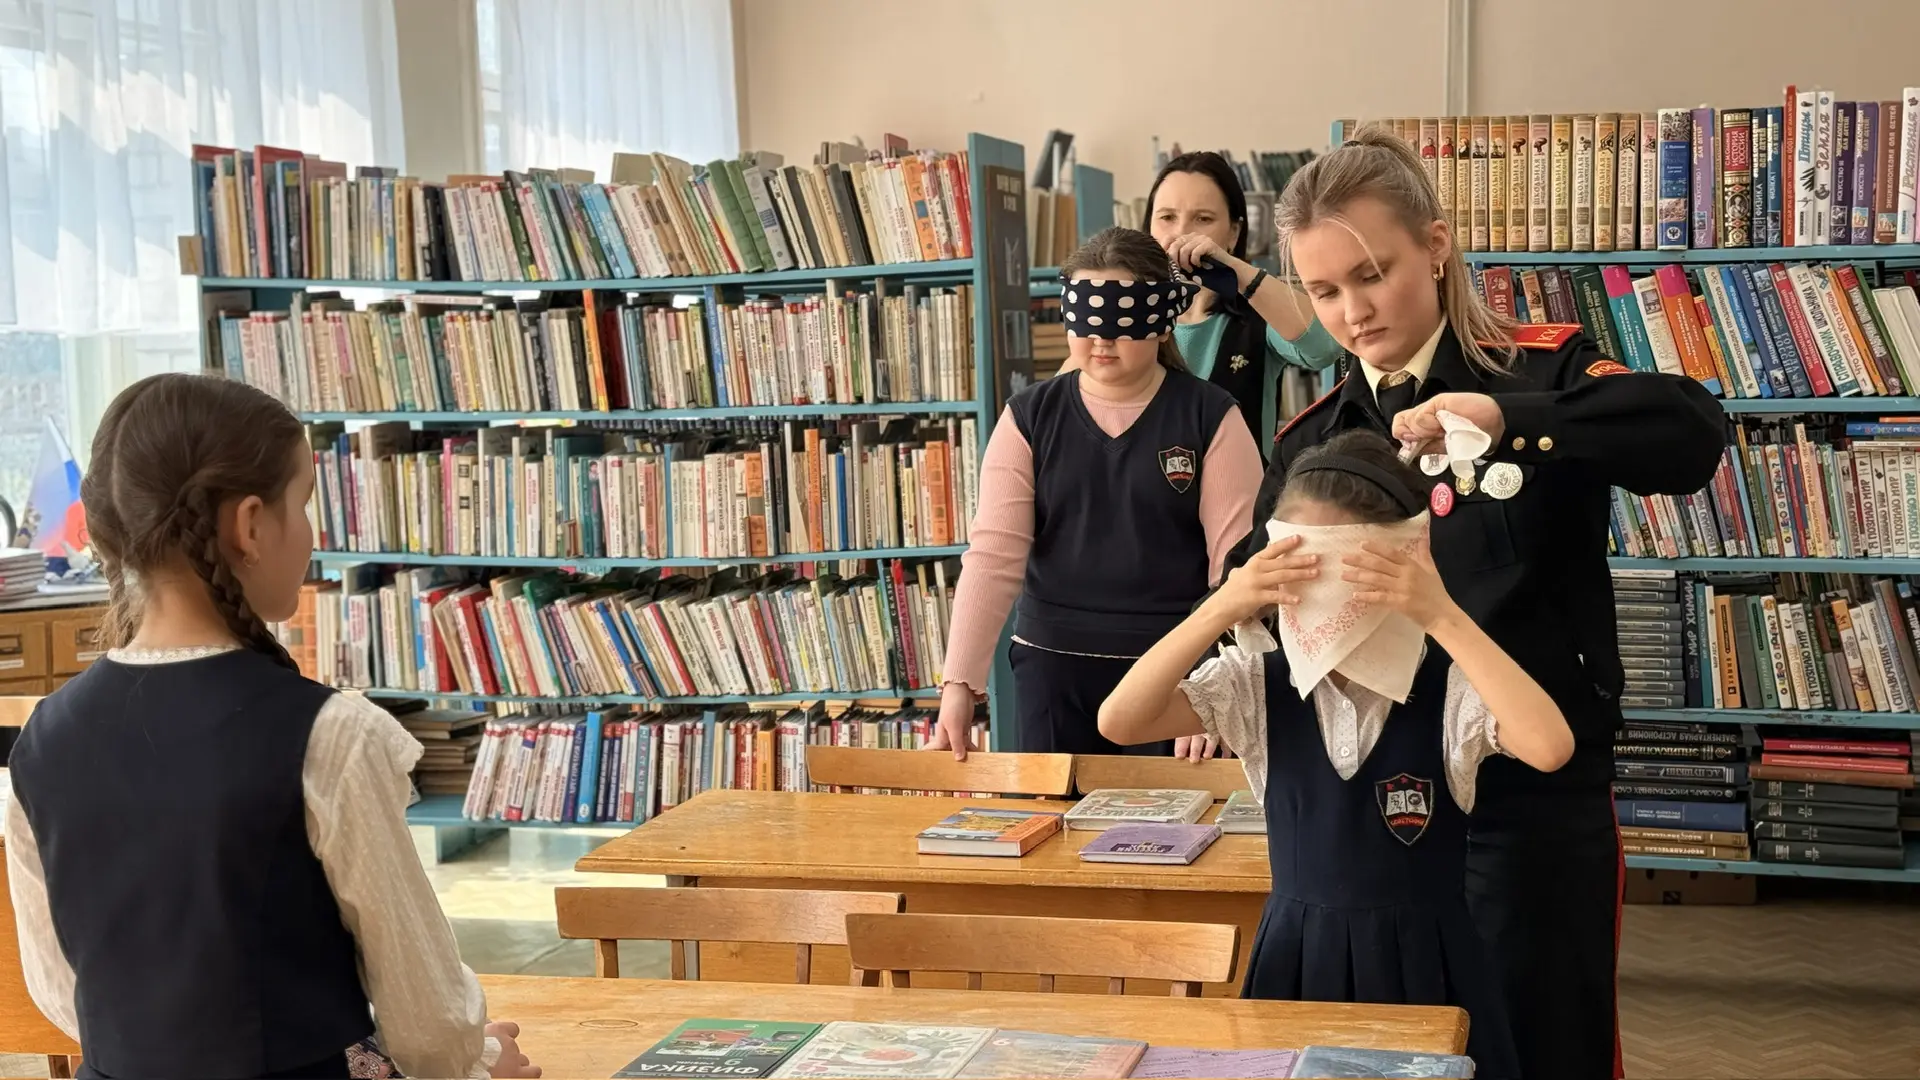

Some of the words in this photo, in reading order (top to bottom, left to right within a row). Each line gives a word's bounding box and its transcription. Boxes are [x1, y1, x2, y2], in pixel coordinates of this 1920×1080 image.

[1730, 130, 1739, 166] ИСТОРИЯ
[1798, 111, 1813, 163] Птицы
[1815, 112, 1829, 170] Земля
[1901, 111, 1918, 189] Растения
[1755, 183, 1763, 215] ФИЗИКА
[1800, 284, 1828, 329] ШКОЛЬНИКА
[1832, 316, 1847, 333] Кто
[1773, 334, 1793, 374] РОССИИ
[1779, 332, 1799, 371] ГОРОДА
[1817, 327, 1850, 382] СПРАВОЧНИК
[1849, 356, 1864, 375] Что
[1860, 479, 1871, 499] МИР
[1888, 476, 1900, 496] МИР
[1904, 472, 1915, 495] МИР
[1864, 500, 1876, 539] ПОЗНАЮ
[1891, 498, 1902, 535] ПОЗНАЮ
[1907, 497, 1918, 539] ПОЗНАЮ
[884, 574, 897, 616] СКАЗКИ
[1684, 580, 1695, 624] ХИМИИ
[1905, 607, 1920, 638] ИСТОРИЯ
[1687, 630, 1697, 655] МИР
[1796, 629, 1808, 649] МИР
[1802, 650, 1817, 688] ПОЗНАЮ
[1878, 643, 1903, 706] СПРАВОЧНИК
[1616, 745, 1699, 755] ЭНЦИКЛОПЕДИЯ
[1628, 730, 1676, 739] АСТРОНОМИЯ
[1665, 767, 1704, 776] ПУШКИН
[1633, 786, 1688, 795] ИНОСТРАННЫХ
[1690, 788, 1722, 796] СЛОВАРЬ
[640, 1063, 758, 1073] ФИЗИКА
[722, 1057, 742, 1065] 9
